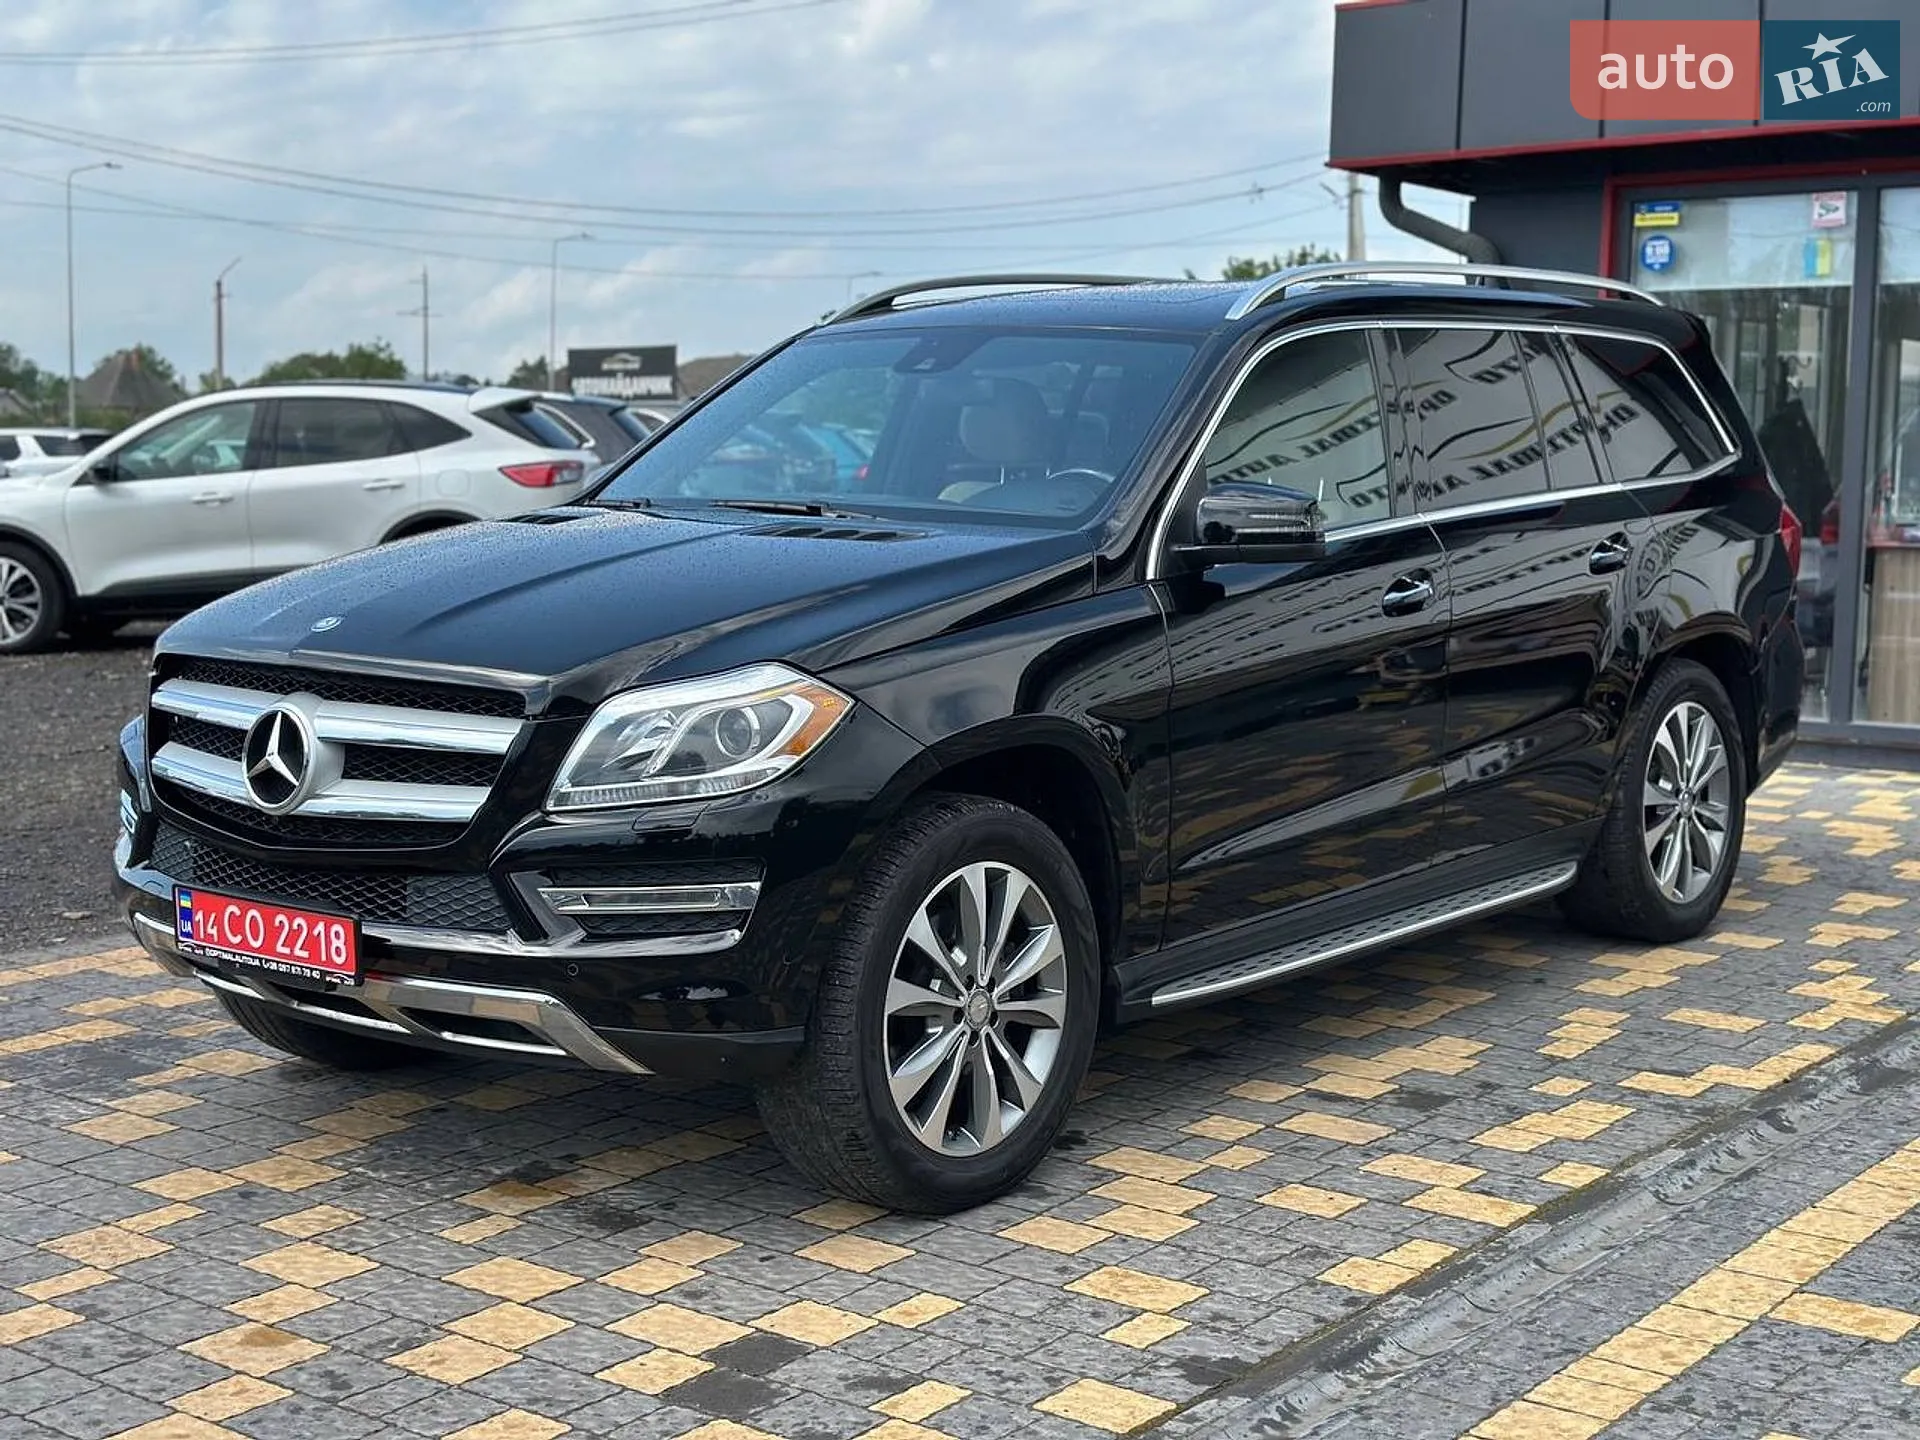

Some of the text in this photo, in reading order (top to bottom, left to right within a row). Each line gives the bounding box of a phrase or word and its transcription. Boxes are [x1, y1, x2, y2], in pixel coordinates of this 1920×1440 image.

[181, 919, 193, 934] UA
[195, 905, 347, 965] 14 CO 2218
